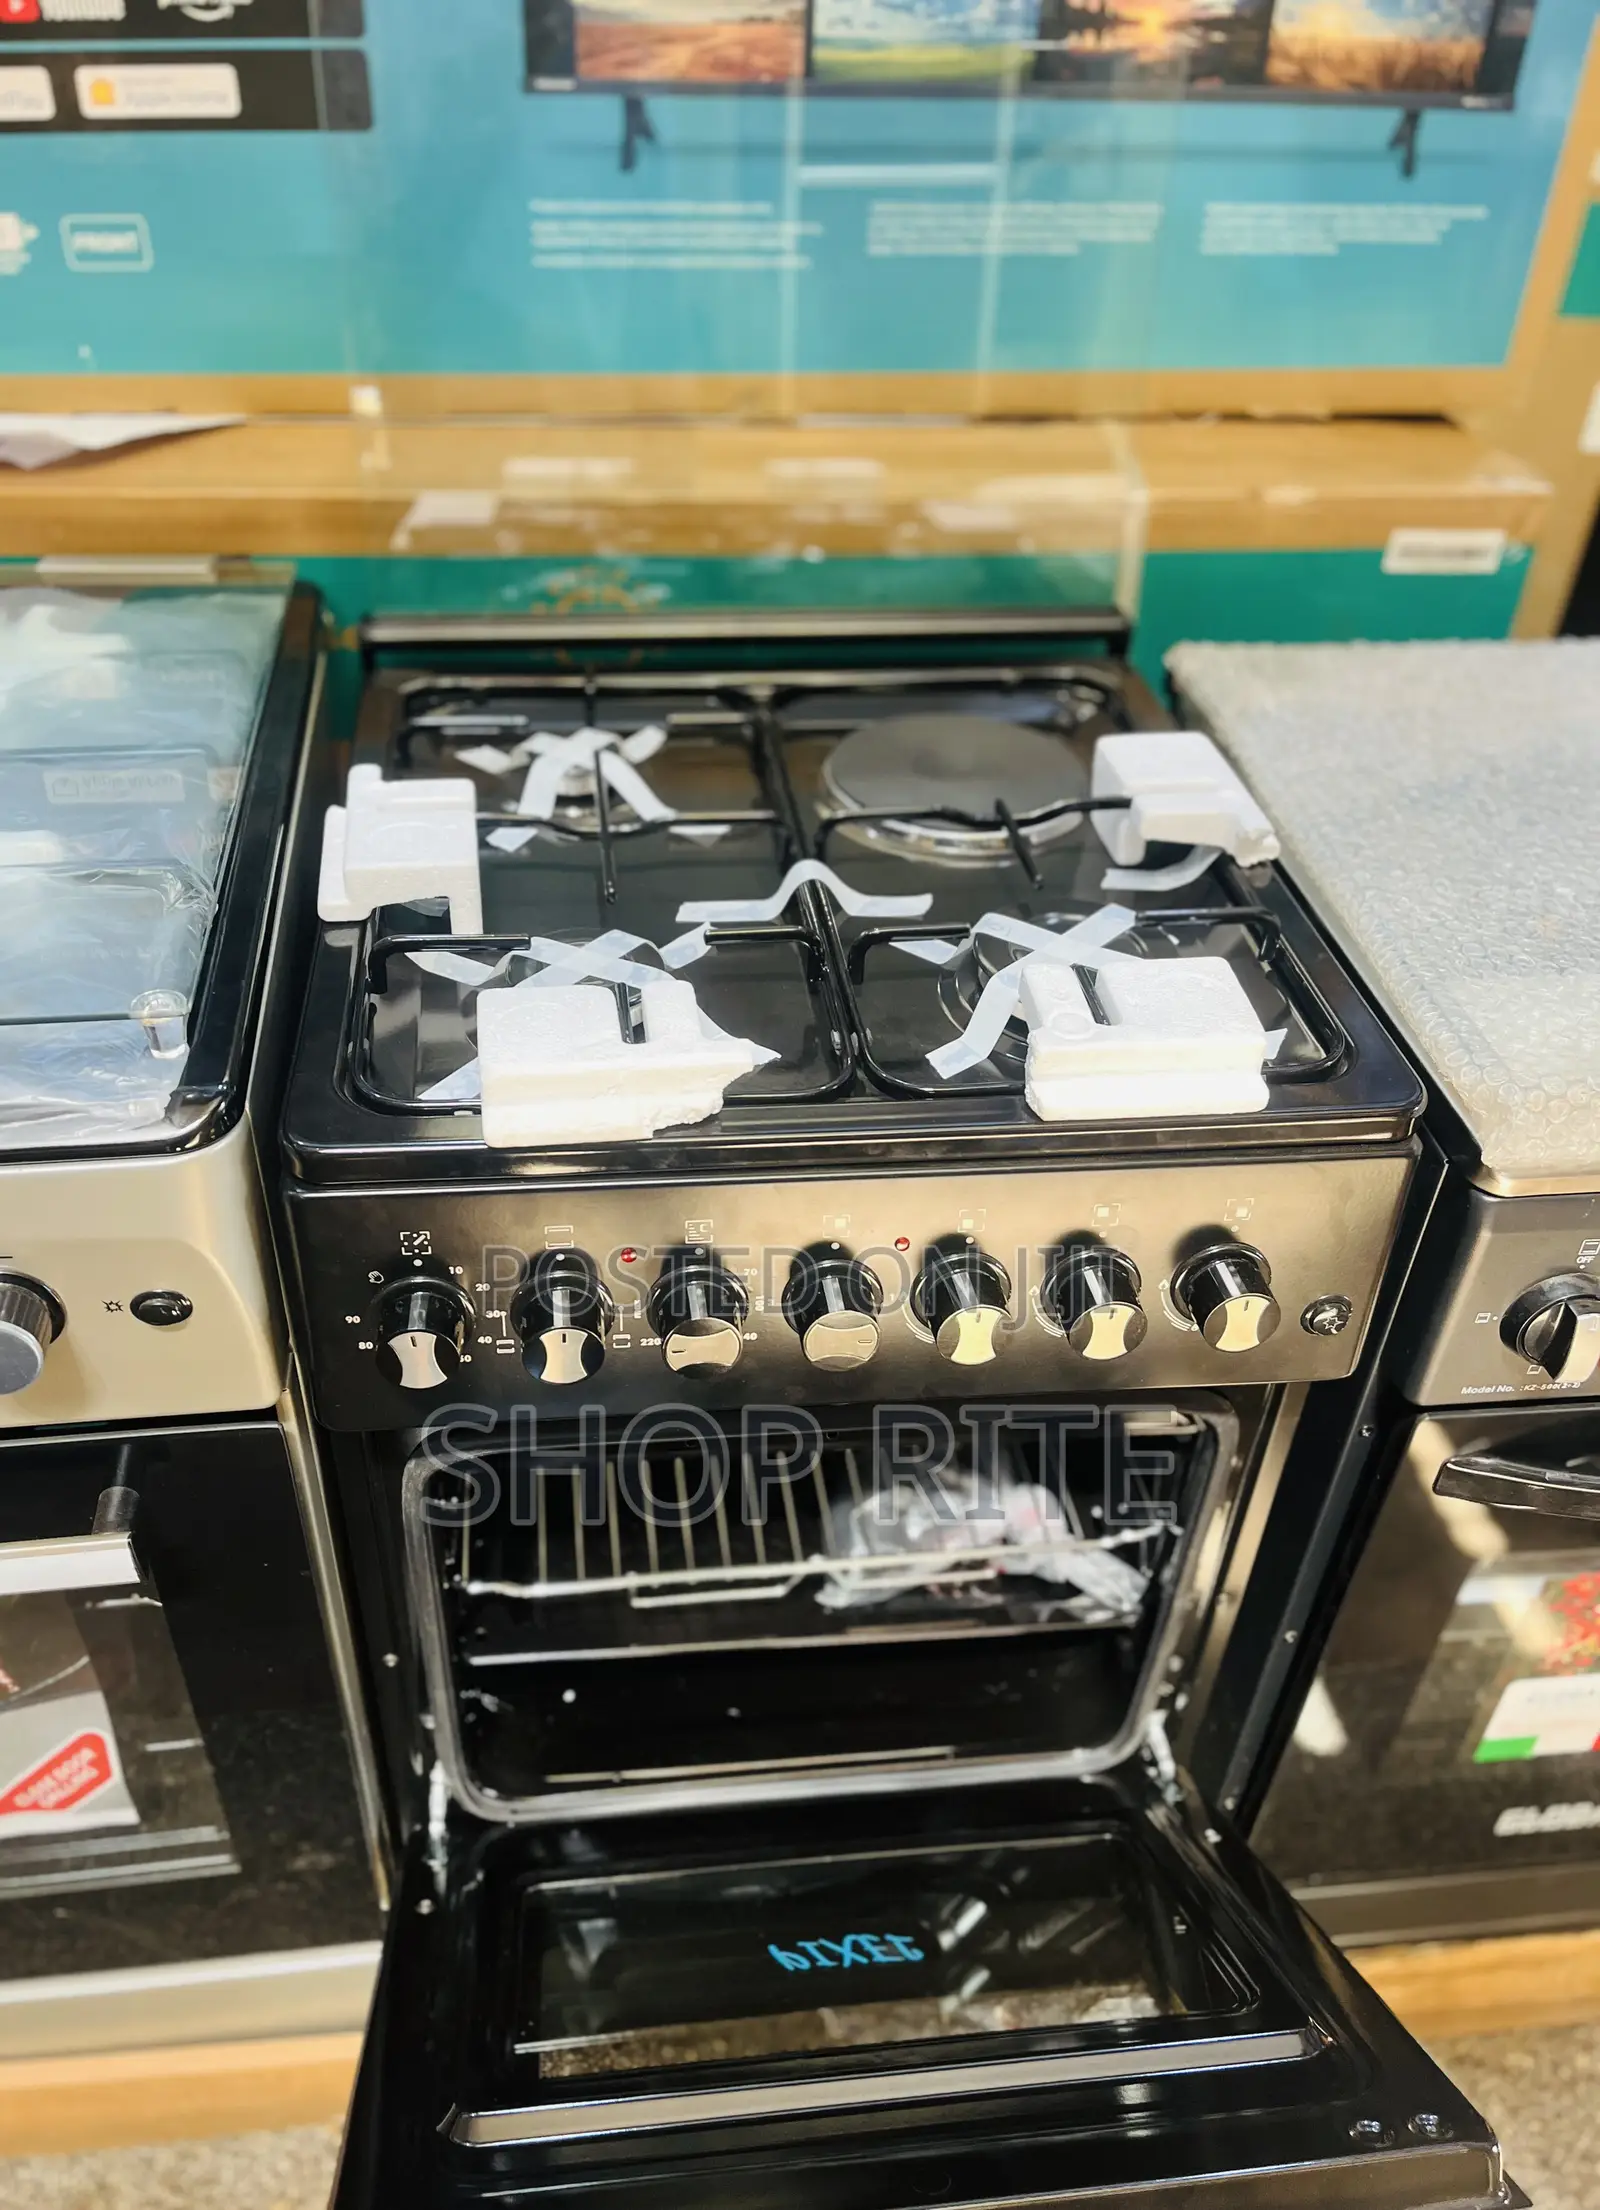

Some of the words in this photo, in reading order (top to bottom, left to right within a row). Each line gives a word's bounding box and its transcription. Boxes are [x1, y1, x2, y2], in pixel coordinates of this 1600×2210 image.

[448, 1266, 464, 1275] 10
[743, 1268, 758, 1276] 70
[475, 1283, 491, 1292] 20
[486, 1310, 501, 1318] 30
[345, 1315, 361, 1324] 90
[477, 1336, 492, 1344] 40
[640, 1337, 661, 1347] 220
[358, 1341, 373, 1350] 80
[1461, 1385, 1495, 1394] Model
[1496, 1384, 1515, 1393] No.
